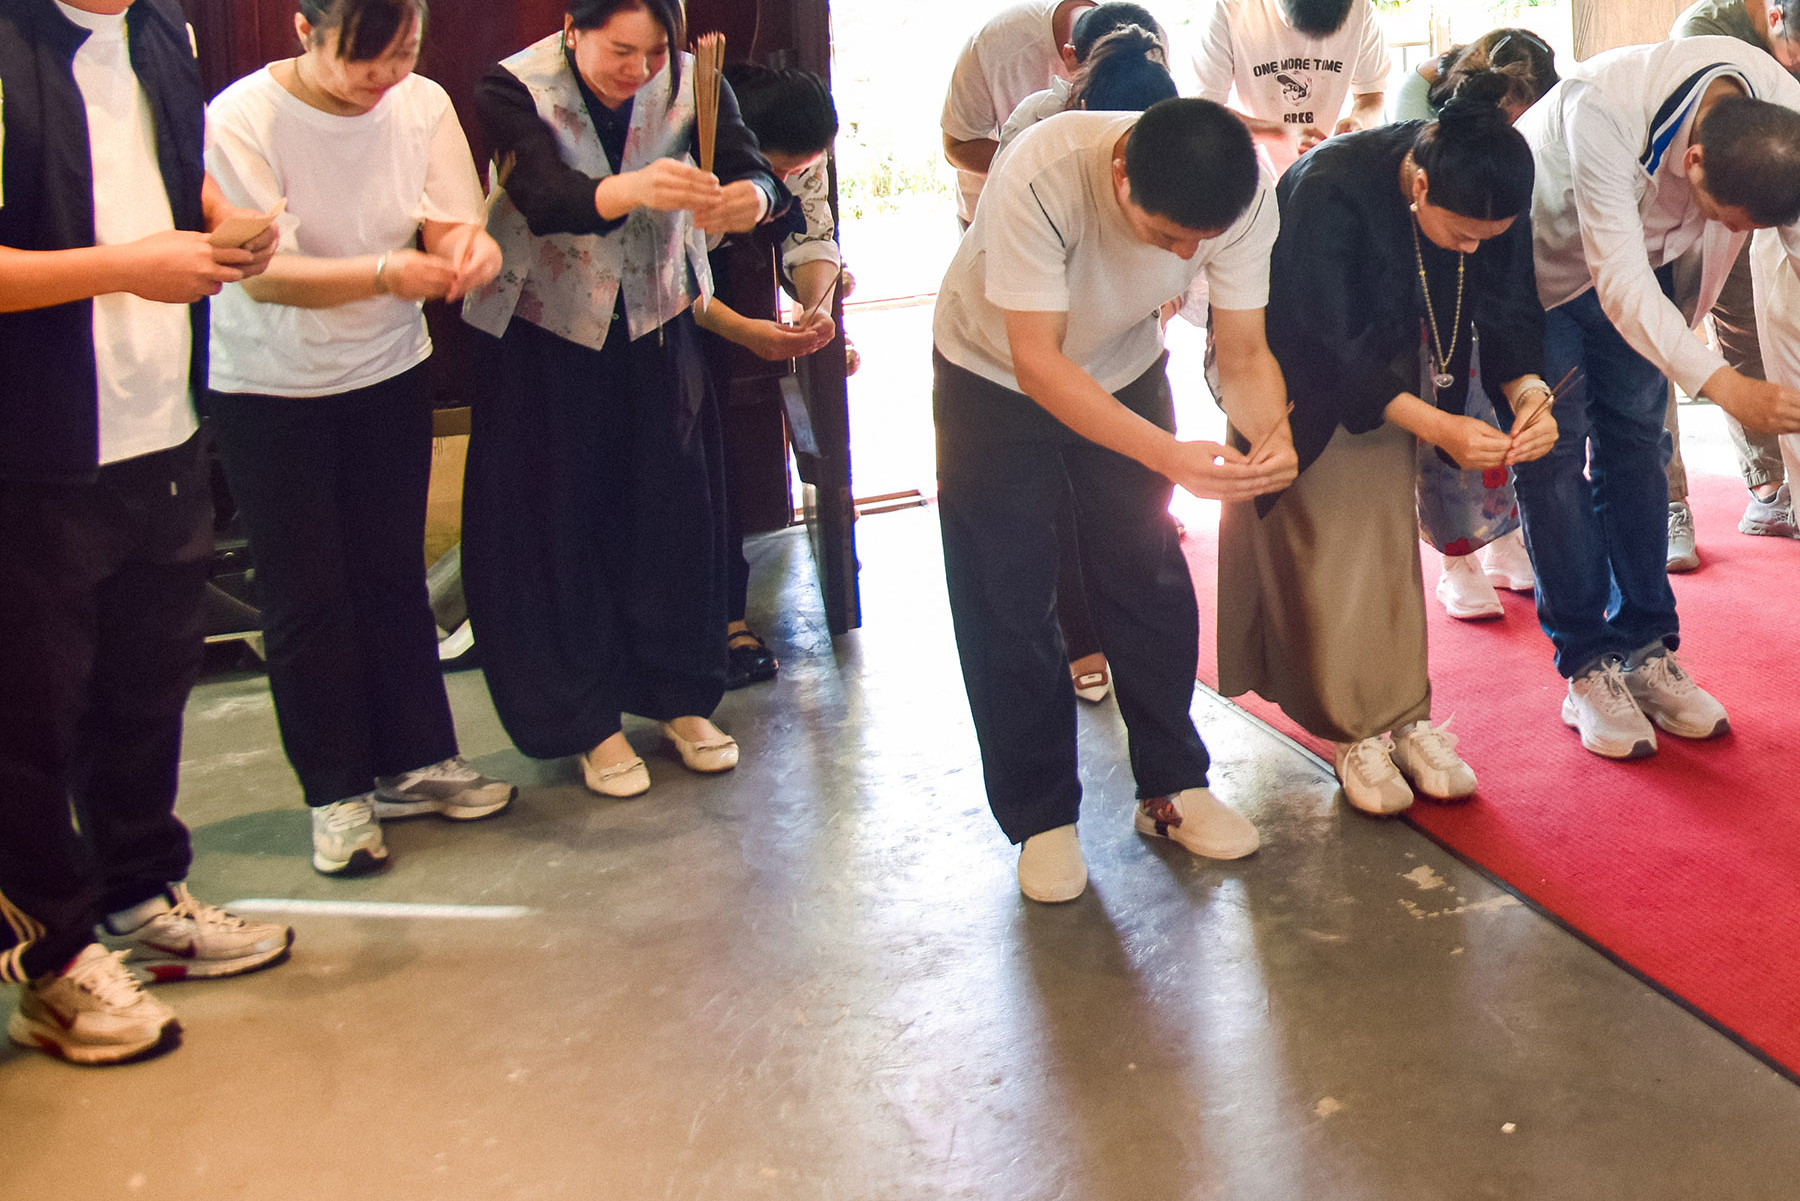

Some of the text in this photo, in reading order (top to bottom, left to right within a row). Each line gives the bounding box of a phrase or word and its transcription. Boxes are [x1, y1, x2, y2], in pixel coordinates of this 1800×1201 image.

[1253, 58, 1343, 77] ONE MORE TIME
